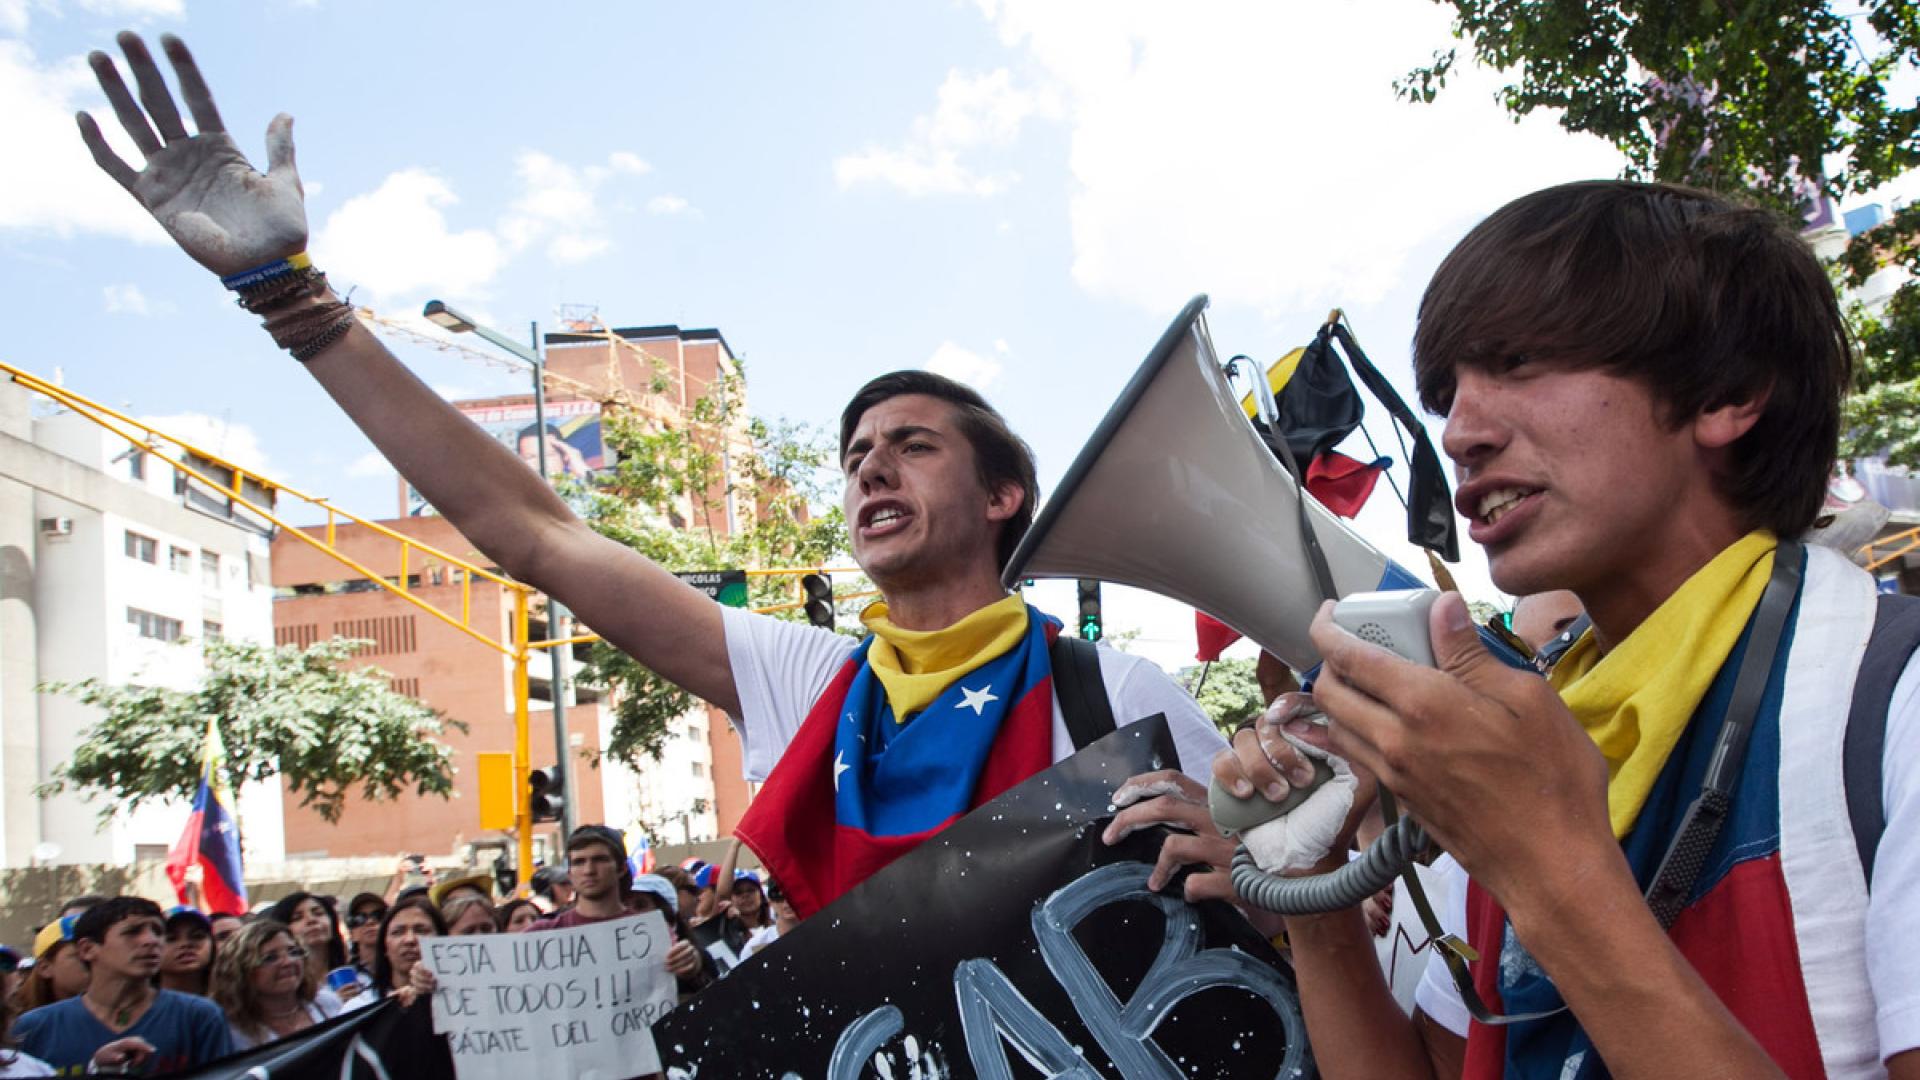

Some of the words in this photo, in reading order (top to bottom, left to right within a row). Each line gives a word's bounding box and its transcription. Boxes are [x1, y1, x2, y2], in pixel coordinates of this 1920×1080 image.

[431, 943, 497, 975] ESTA
[513, 934, 598, 973] LUCHA
[615, 921, 652, 961] ES
[436, 986, 479, 1016] DE
[552, 1020, 599, 1048] DEL
